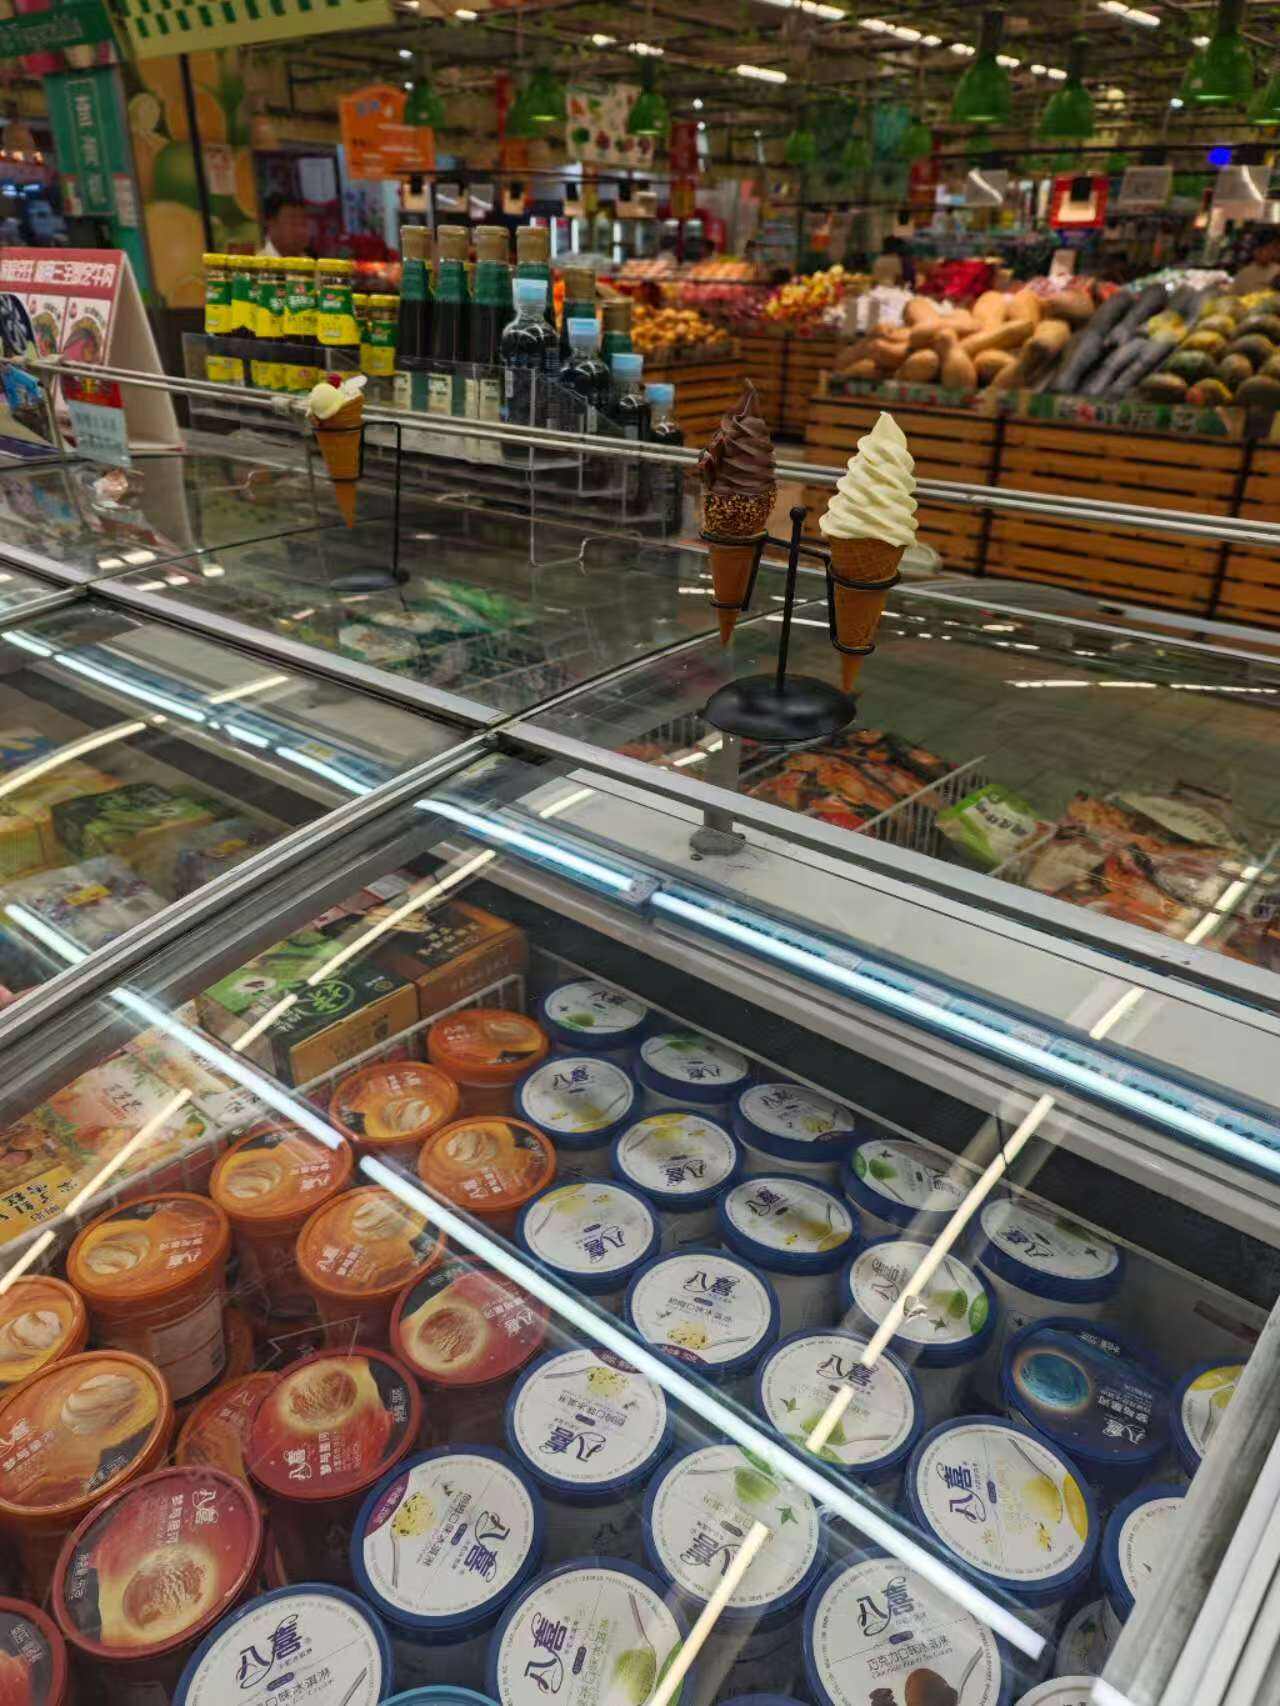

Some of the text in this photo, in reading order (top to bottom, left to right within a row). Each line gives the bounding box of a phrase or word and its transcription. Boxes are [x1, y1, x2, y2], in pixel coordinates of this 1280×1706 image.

[553, 1066, 591, 1088] 八喜
[666, 1160, 706, 1185] 八喜
[745, 1186, 785, 1216] 八喜
[584, 1226, 625, 1263] 八喜
[1003, 1225, 1053, 1257] 八喜
[683, 1271, 740, 1297] 八喜
[816, 1354, 879, 1387] 八喜
[539, 1426, 606, 1463] 八喜
[1102, 1418, 1146, 1444] 八喜
[283, 1448, 312, 1480] 八喜
[192, 1488, 219, 1524] 八喜
[936, 1462, 986, 1522] 八喜
[464, 1510, 510, 1583] 八喜
[857, 1576, 915, 1636] 八喜
[236, 1614, 302, 1689] 八喜
[524, 1612, 567, 1693] 八喜
